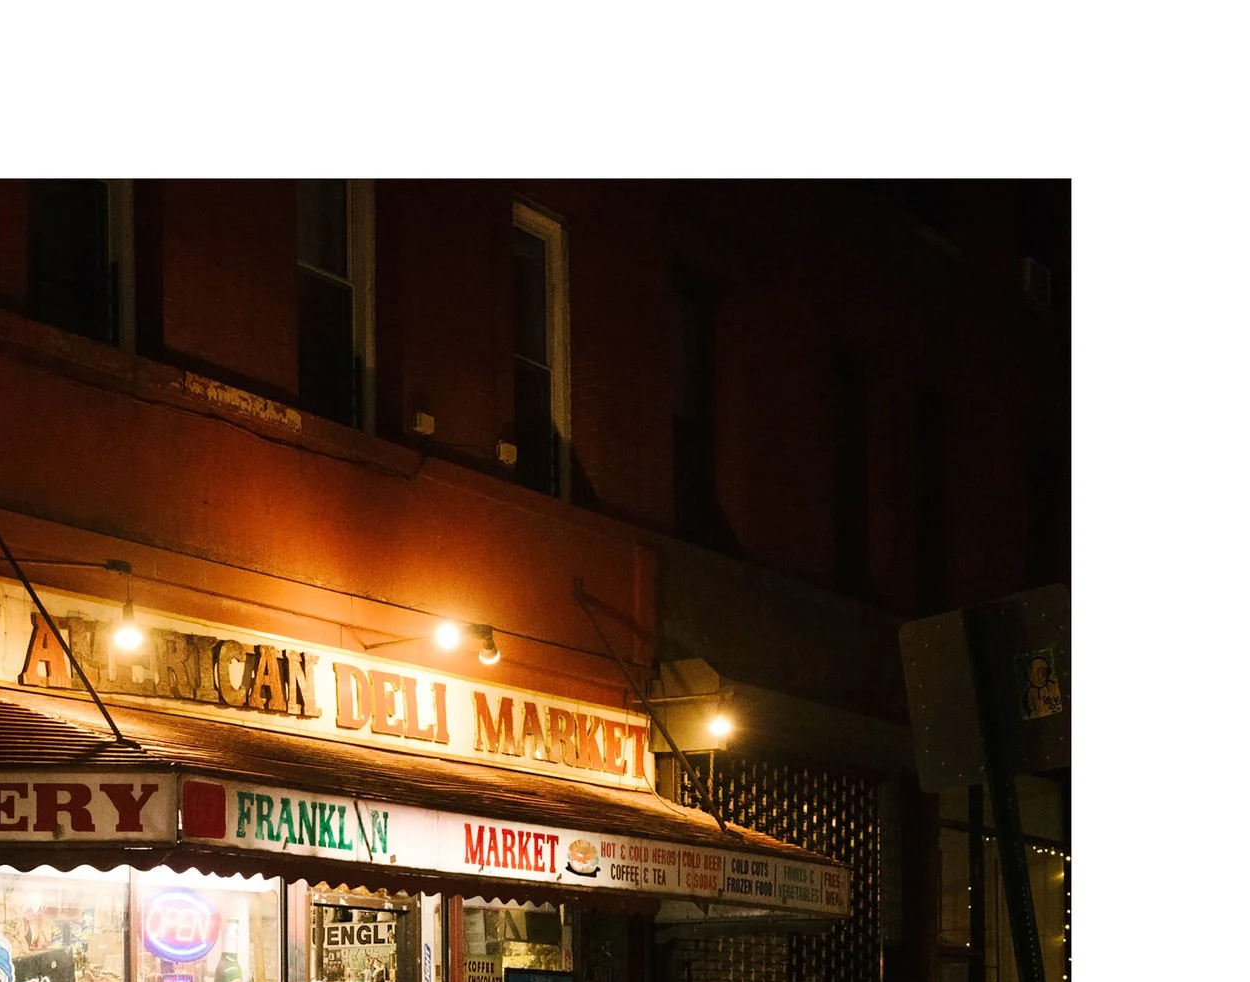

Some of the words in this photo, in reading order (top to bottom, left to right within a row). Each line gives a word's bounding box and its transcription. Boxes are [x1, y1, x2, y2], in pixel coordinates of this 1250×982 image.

[333, 662, 450, 744] DELI
[472, 691, 648, 777] MARKET
[236, 791, 389, 855] FRANKLN
[464, 822, 560, 874] MARKET
[601, 841, 617, 859] HOT
[629, 845, 649, 864] COLD
[682, 851, 701, 869] COLD
[704, 854, 722, 872] BEER
[731, 857, 749, 875] COLD
[751, 861, 769, 878] CUTS
[610, 863, 640, 884] COFFEE
[653, 868, 667, 886] TEA
[726, 877, 753, 896] FROZEN
[755, 881, 773, 898] FOOD
[146, 904, 211, 944] OPEN
[468, 960, 495, 973] COFFEE
